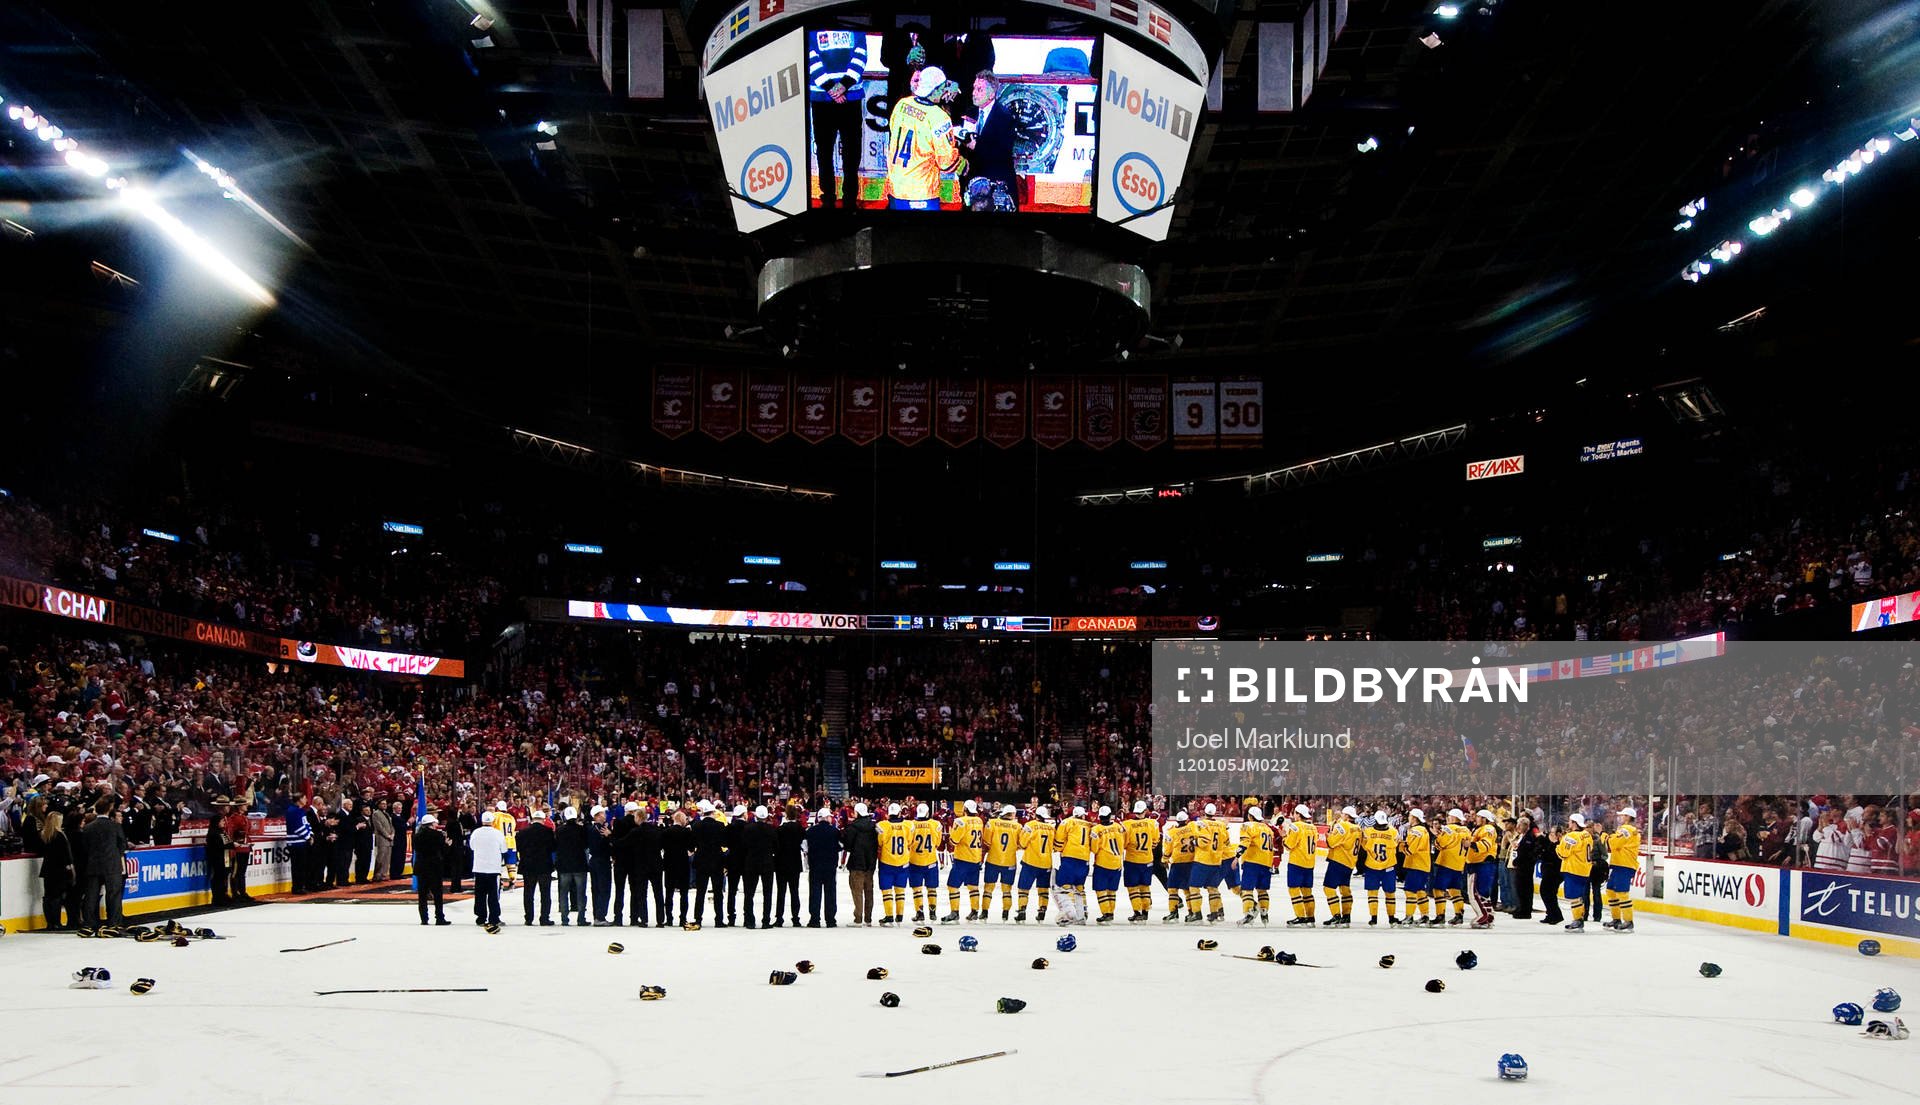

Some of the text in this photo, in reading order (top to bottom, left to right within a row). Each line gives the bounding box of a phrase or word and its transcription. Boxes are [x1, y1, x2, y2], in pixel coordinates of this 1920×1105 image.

[714, 75, 775, 132] Mobil
[1105, 69, 1169, 130] Mobil
[893, 127, 914, 168] 14
[748, 161, 785, 193] Esso
[1121, 164, 1158, 201] Esso
[1187, 402, 1203, 429] 9
[1222, 402, 1261, 428] 30
[57, 591, 189, 636] CHAMPIONSHIP
[196, 622, 247, 648] CANADA
[769, 614, 814, 628] 2012
[929, 617, 934, 628] 1
[943, 622, 959, 630] 9:51
[1077, 619, 1137, 630] CANADA
[904, 769, 926, 779] 2012
[503, 822, 513, 836] 14
[1081, 828, 1086, 846] 1
[891, 836, 904, 855] 18
[915, 834, 932, 853] 24
[969, 829, 983, 849] 23
[1001, 832, 1009, 852] 9
[1041, 835, 1048, 854] 7
[1109, 838, 1120, 856] 11
[1135, 832, 1148, 851] 12
[1212, 832, 1218, 851] 5
[1374, 844, 1387, 861] 15
[141, 861, 178, 883] TIM-BR
[1677, 870, 1744, 900] SAFEWAY
[1847, 889, 1920, 920] TELUS
